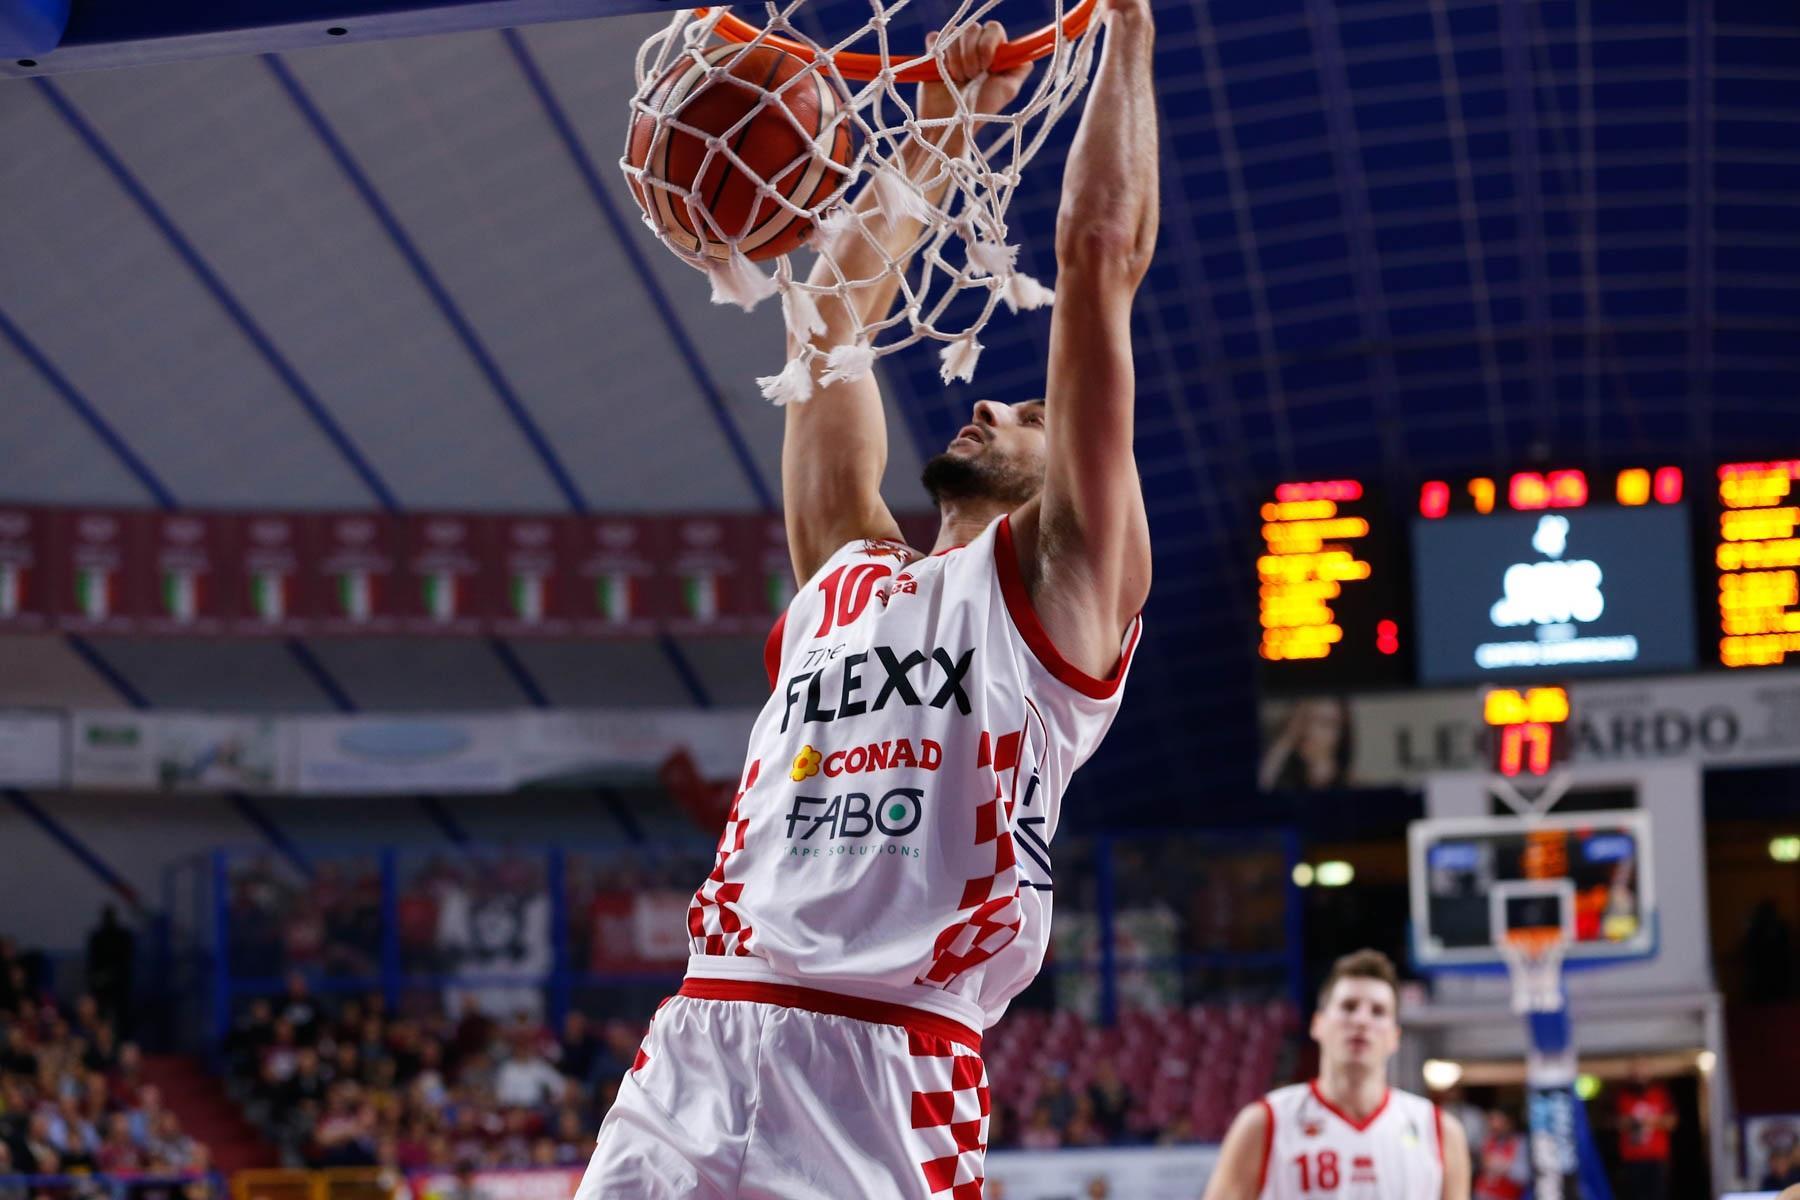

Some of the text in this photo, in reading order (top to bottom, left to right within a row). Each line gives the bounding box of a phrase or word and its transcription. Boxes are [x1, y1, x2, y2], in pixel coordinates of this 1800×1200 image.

[814, 563, 892, 638] 10
[780, 646, 976, 734] FLEXX
[822, 738, 943, 778] CONAD
[1396, 705, 1738, 770] LEARDO
[785, 788, 924, 840] FABO
[828, 844, 920, 858] SOLUTIONS
[1295, 1150, 1339, 1193] 18
